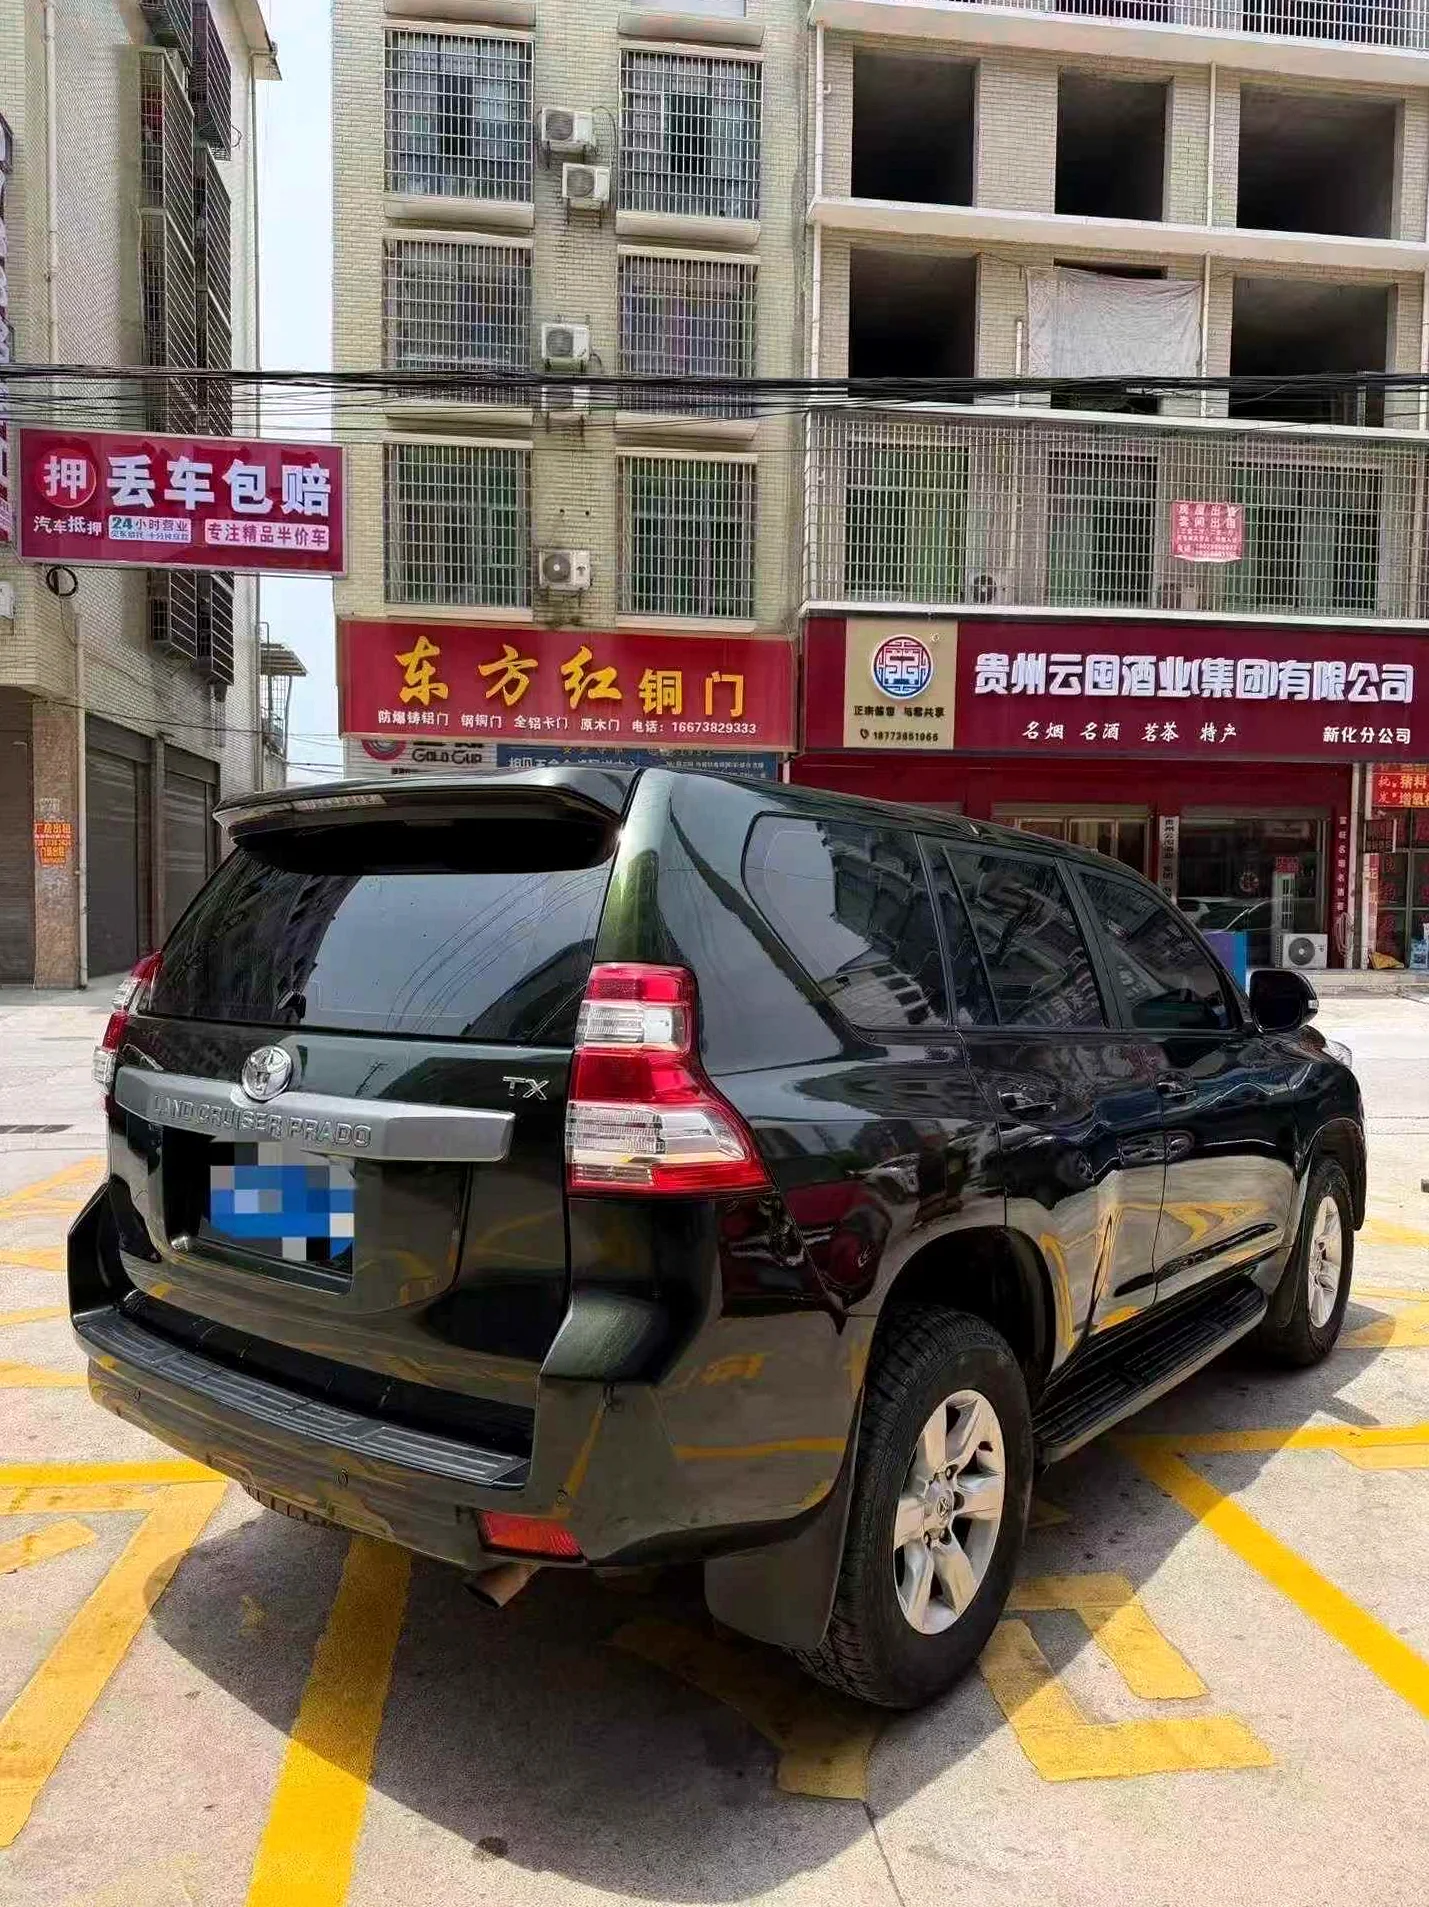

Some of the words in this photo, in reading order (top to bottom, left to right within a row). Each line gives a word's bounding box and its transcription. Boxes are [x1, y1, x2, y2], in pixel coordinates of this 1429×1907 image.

[43, 454, 88, 500] 押
[106, 454, 331, 517] 丢车包赔
[33, 515, 102, 536] 汽车抵押
[111, 516, 188, 532] 24小时营业
[207, 522, 328, 547] 专注精品半价车
[396, 635, 745, 717] 东方红铜门
[377, 709, 449, 726] 防爆铸铝门
[580, 718, 620, 732] 原木门
[671, 721, 757, 735] 16673829333
[1022, 721, 1064, 741] 名烟
[1079, 722, 1120, 742] 名酒
[1141, 723, 1179, 742] 茗茶
[1200, 722, 1238, 743] 特产
[1322, 725, 1411, 745] 新化分公司
[412, 748, 450, 762] GOLD
[451, 749, 483, 764] CUP
[502, 1076, 550, 1100] TX
[155, 1094, 195, 1121] LAND
[196, 1104, 284, 1139] CRUISER
[287, 1114, 373, 1148] PRADO
